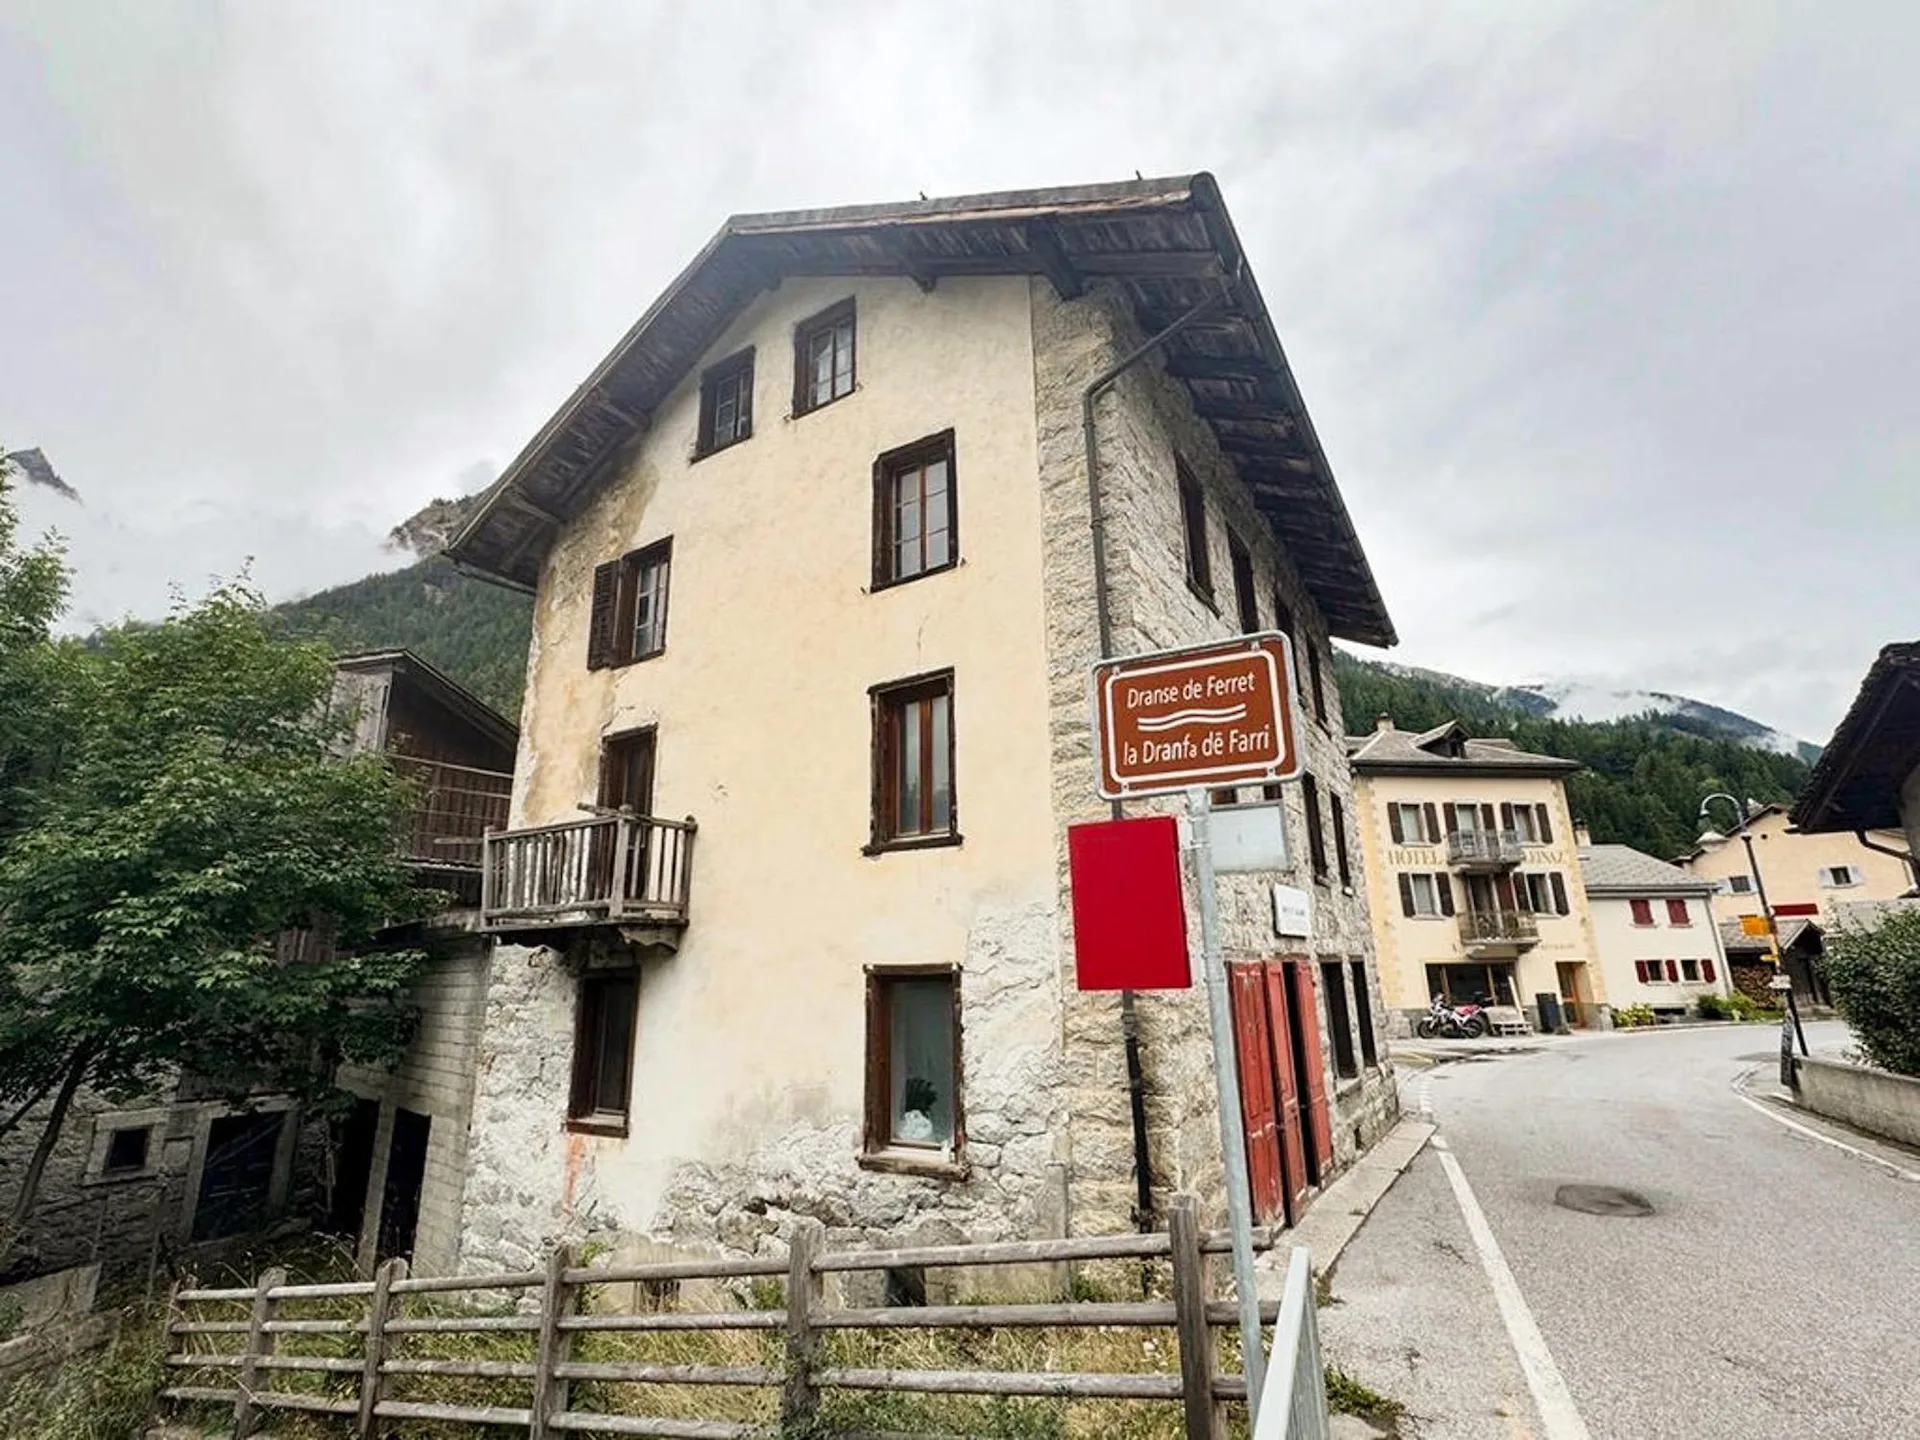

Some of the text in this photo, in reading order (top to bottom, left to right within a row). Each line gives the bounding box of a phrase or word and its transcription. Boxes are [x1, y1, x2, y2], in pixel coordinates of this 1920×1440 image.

[1127, 671, 1255, 709] Dranse de Ferret
[1122, 740, 1138, 766] la
[1229, 723, 1270, 753] Farri
[1387, 849, 1444, 865] HOTEL
